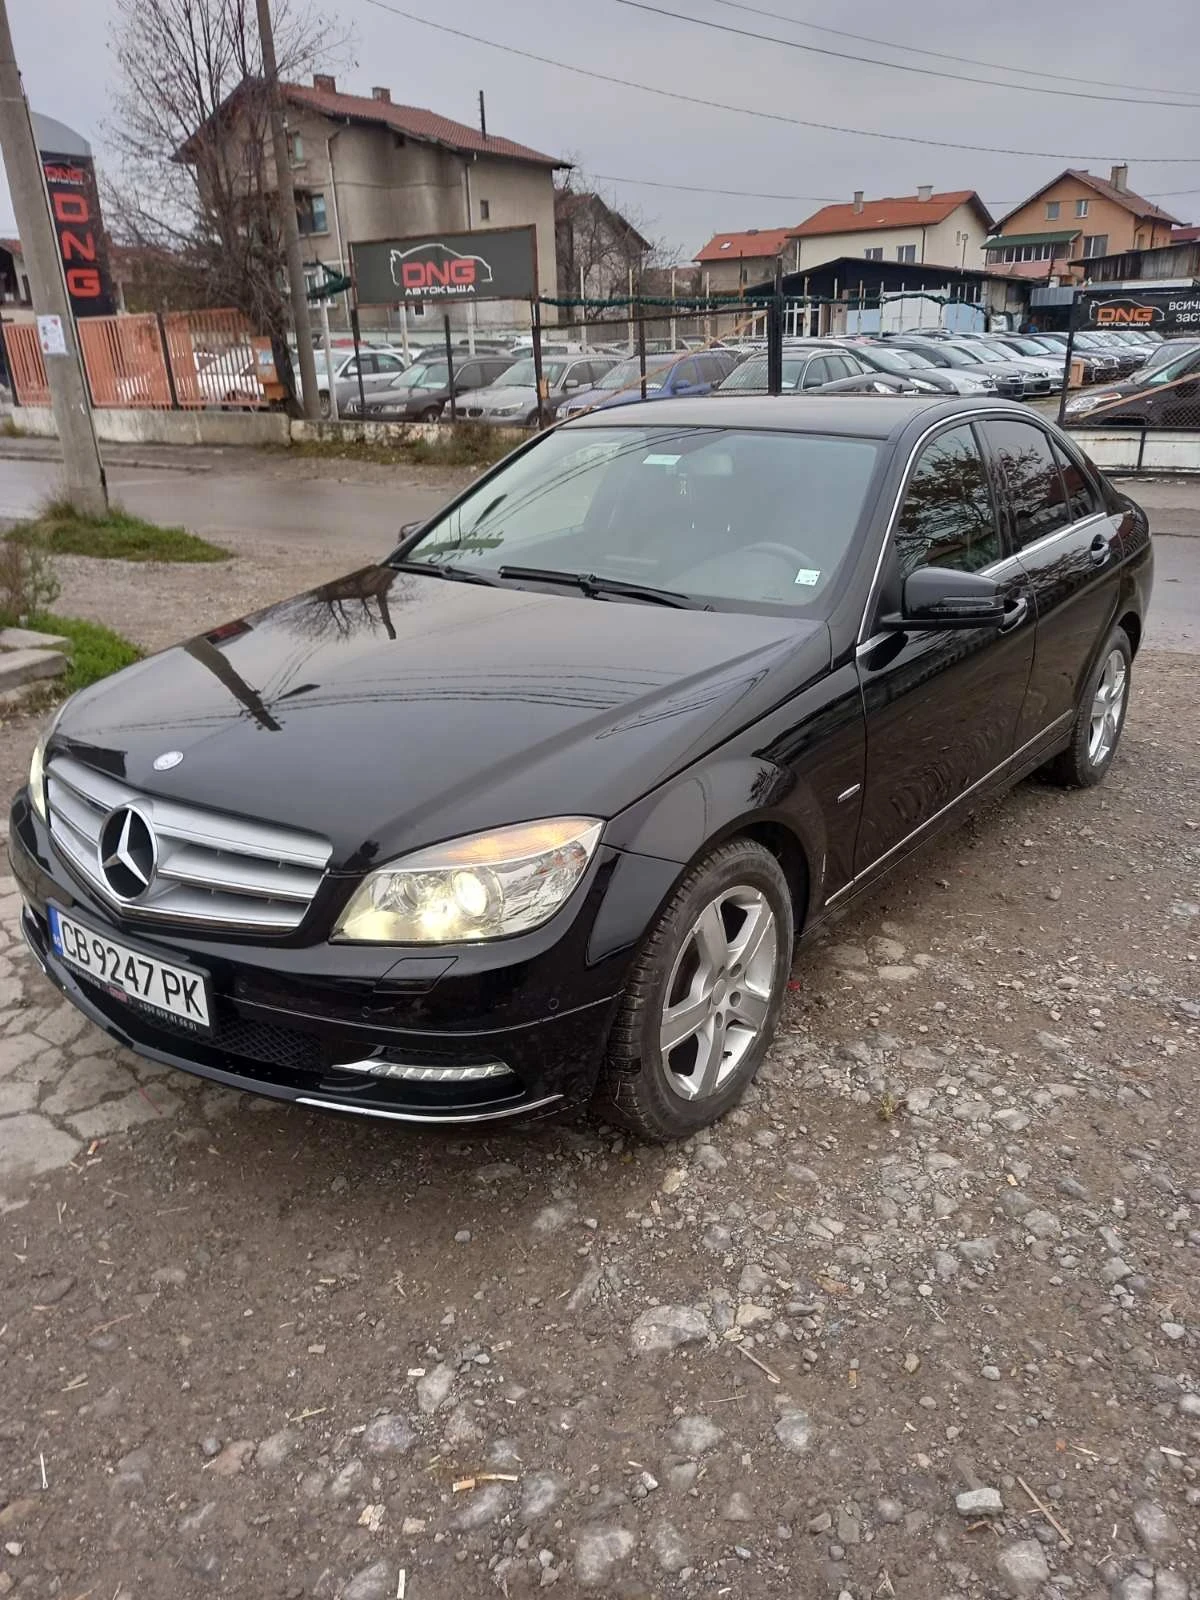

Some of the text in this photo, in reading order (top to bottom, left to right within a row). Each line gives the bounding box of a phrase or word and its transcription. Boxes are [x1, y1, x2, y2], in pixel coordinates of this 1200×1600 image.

[53, 192, 101, 297] DNG
[402, 259, 475, 287] DNG
[404, 284, 475, 296] АВТОКЪША
[1097, 307, 1153, 321] DNG
